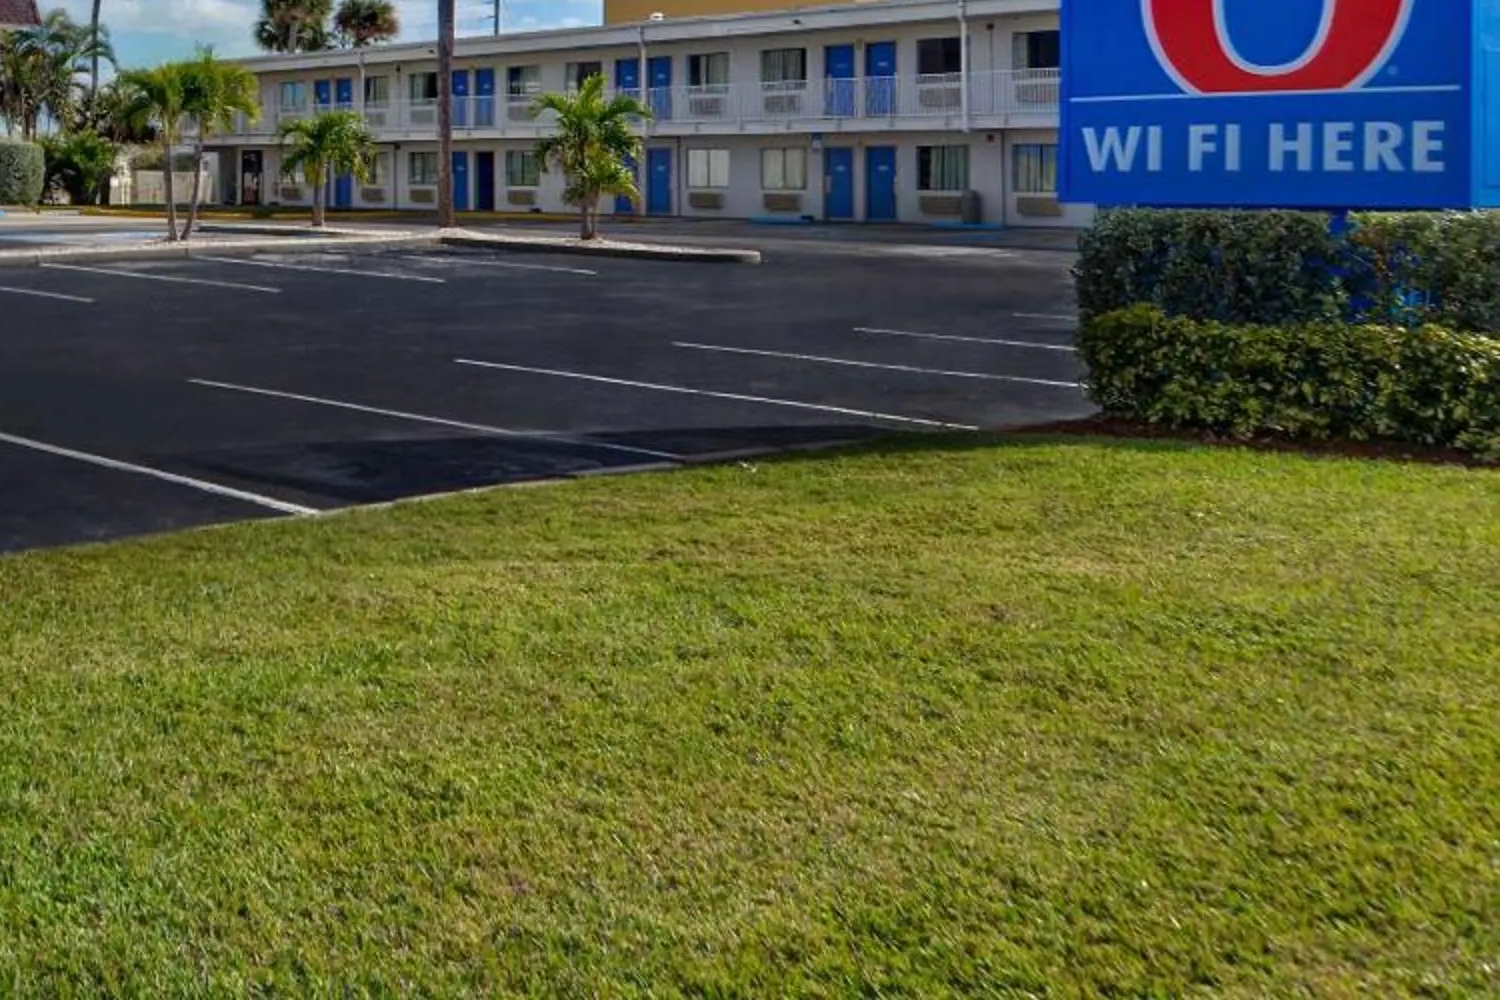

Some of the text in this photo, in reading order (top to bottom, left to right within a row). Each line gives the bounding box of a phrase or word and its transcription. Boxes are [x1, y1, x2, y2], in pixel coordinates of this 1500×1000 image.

[1082, 121, 1445, 172] WI FI HERE
